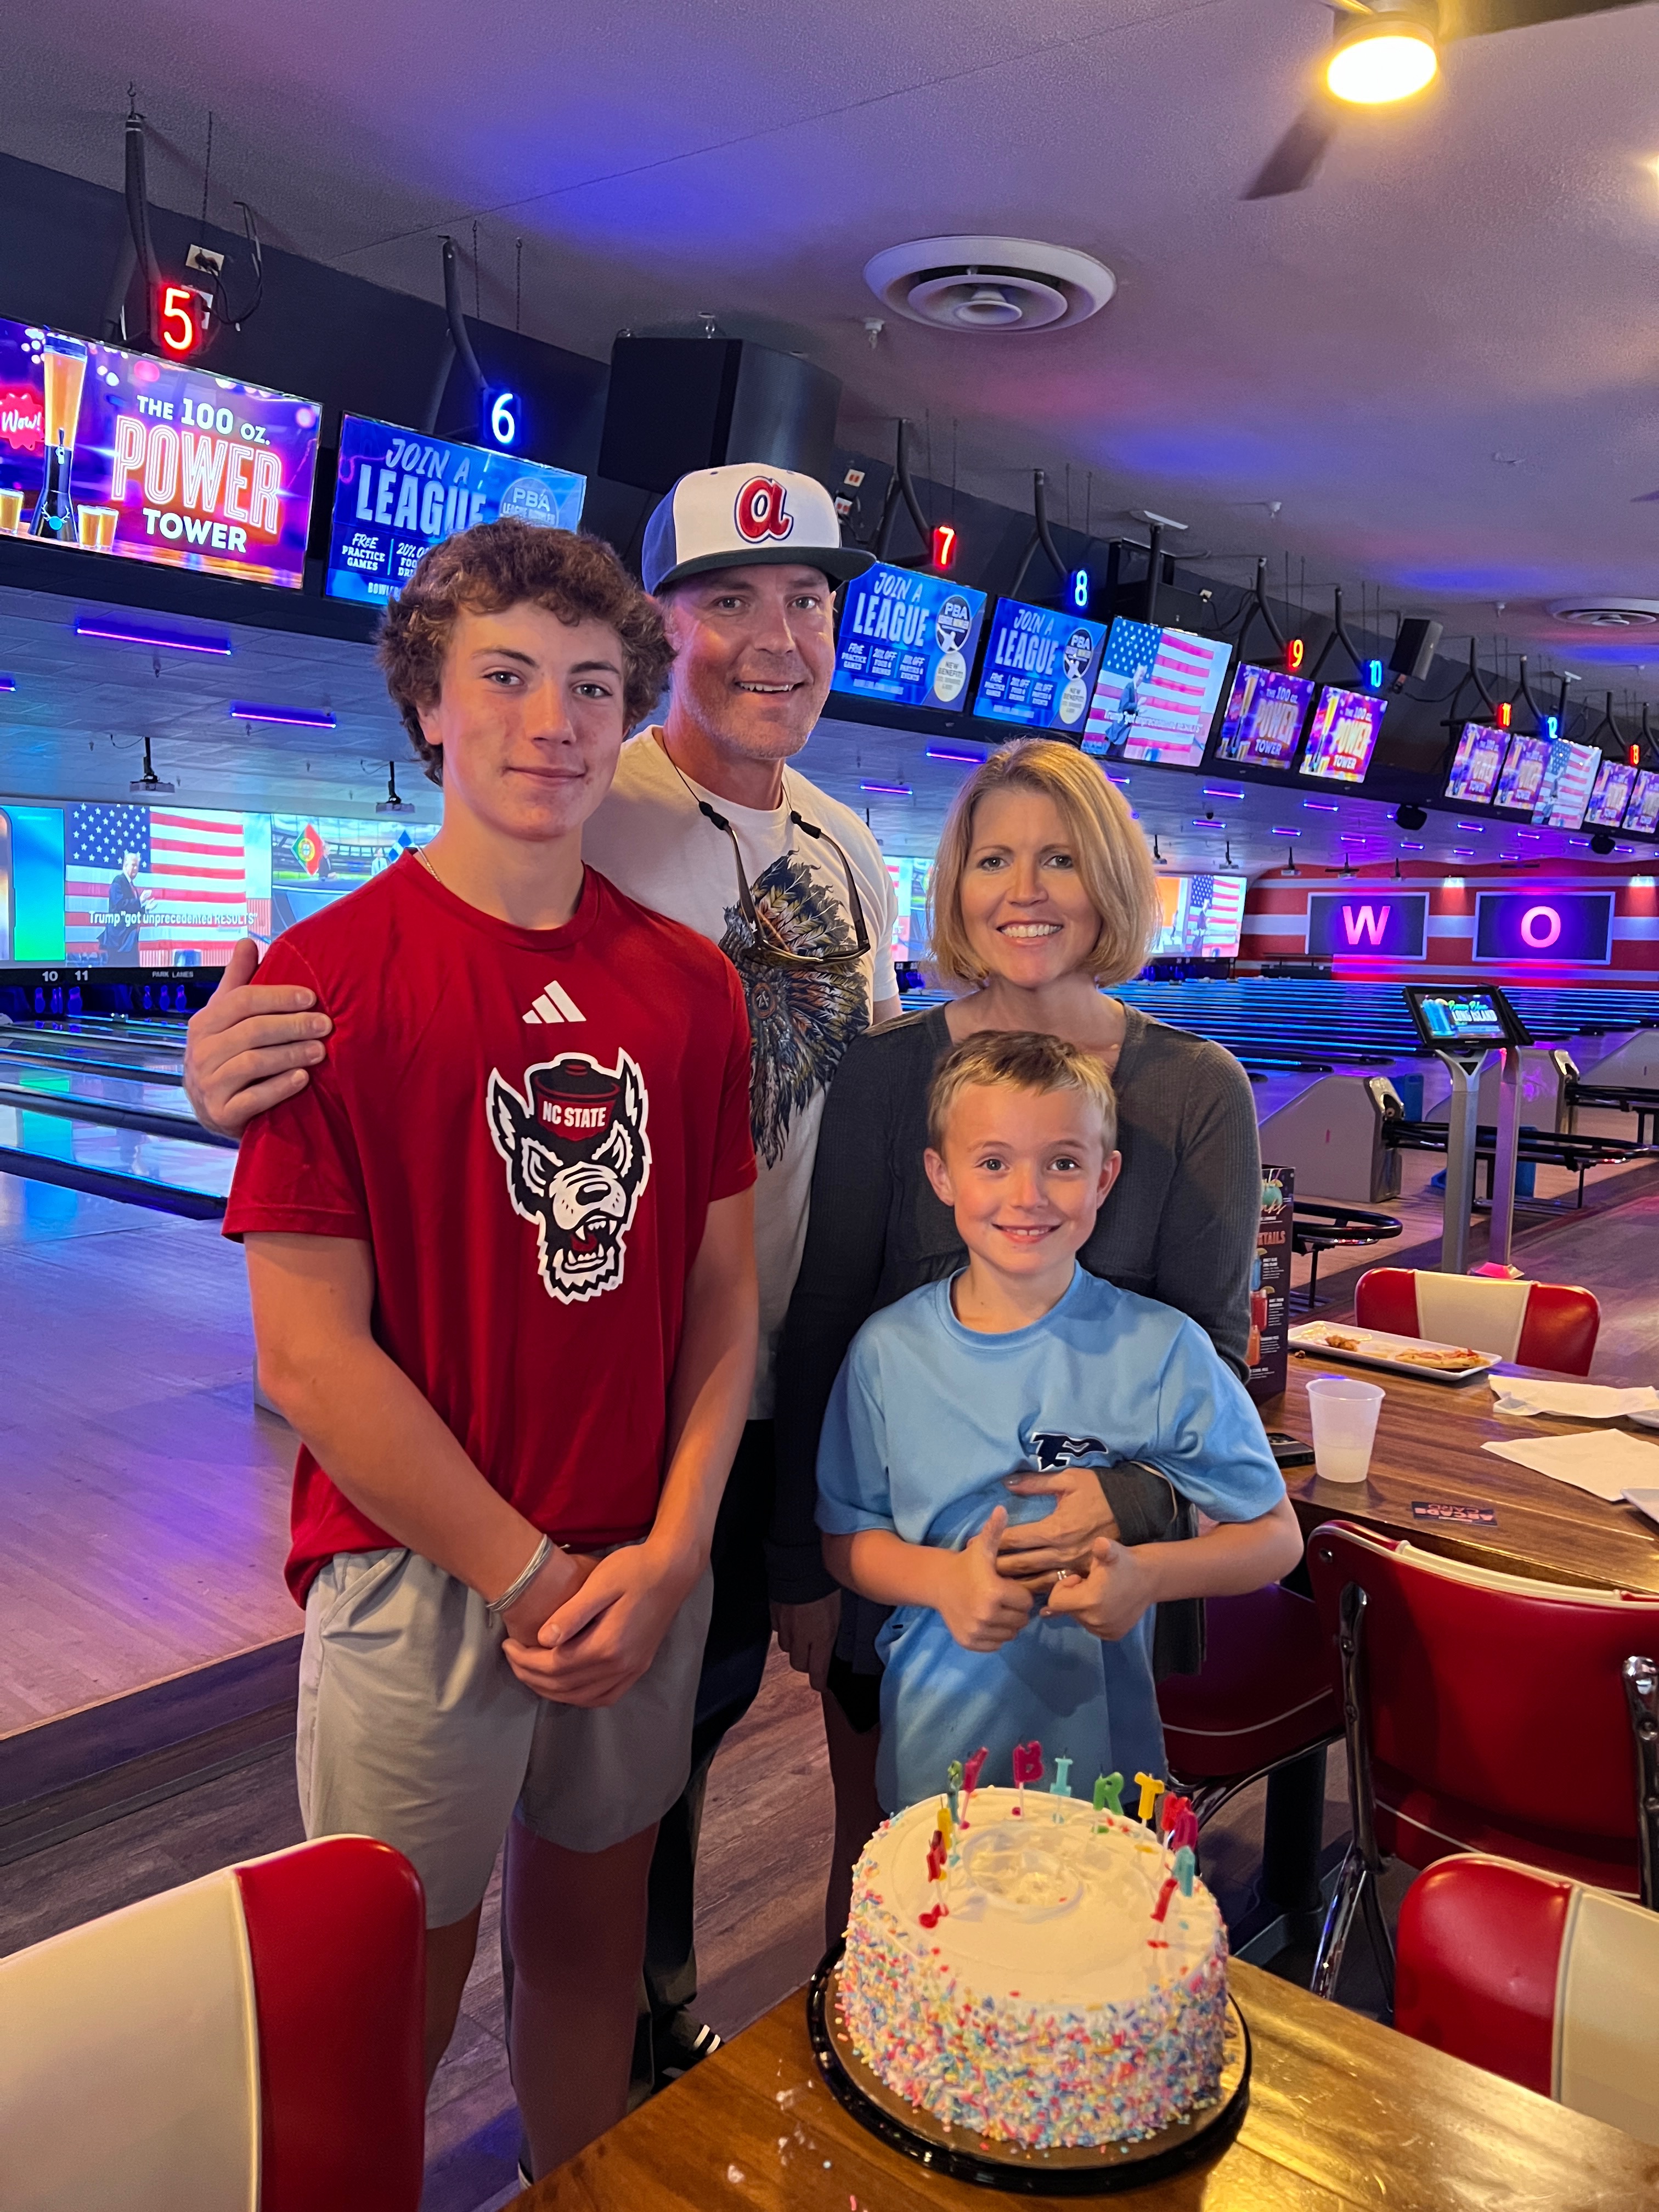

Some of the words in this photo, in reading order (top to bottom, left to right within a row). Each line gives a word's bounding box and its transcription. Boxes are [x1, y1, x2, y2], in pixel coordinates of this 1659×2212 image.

[163, 287, 193, 350] 5
[2, 410, 41, 432] Wow!
[137, 394, 173, 421] THE
[180, 397, 234, 435] 100
[240, 422, 271, 445] OZ.
[491, 393, 515, 443] 6
[385, 438, 450, 479] JOIN
[453, 457, 471, 484] A
[111, 415, 282, 535] POWER
[355, 464, 487, 538] LEAGUE
[512, 487, 550, 512] PBA
[142, 508, 247, 554] TOWER
[352, 532, 379, 549] FREE
[341, 545, 386, 562] PRACTICE
[939, 526, 955, 565] 7
[347, 557, 379, 571] GAMES
[400, 557, 417, 568] FOO
[873, 572, 913, 597] JOIN
[913, 582, 924, 603] A
[1075, 569, 1087, 606] 8
[852, 592, 930, 647] LEAGUE
[944, 602, 968, 620] PBA
[1013, 608, 1046, 636] JOIN
[1045, 618, 1054, 636] A
[995, 627, 1059, 676] LEAGUE
[1070, 634, 1090, 650] PBA
[1292, 639, 1304, 668] 9
[1369, 660, 1383, 687] 10
[1276, 686, 1291, 701] 100
[1255, 739, 1282, 755] TOWER
[1333, 754, 1357, 770] TOWER
[88, 911, 120, 927] Trump
[143, 912, 213, 928] unprecedented
[1341, 905, 1391, 945] W
[1520, 906, 1561, 948] O
[42, 970, 58, 982] 10
[75, 970, 88, 981] 11
[542, 1101, 562, 1125] NC
[563, 1107, 607, 1128] STATE
